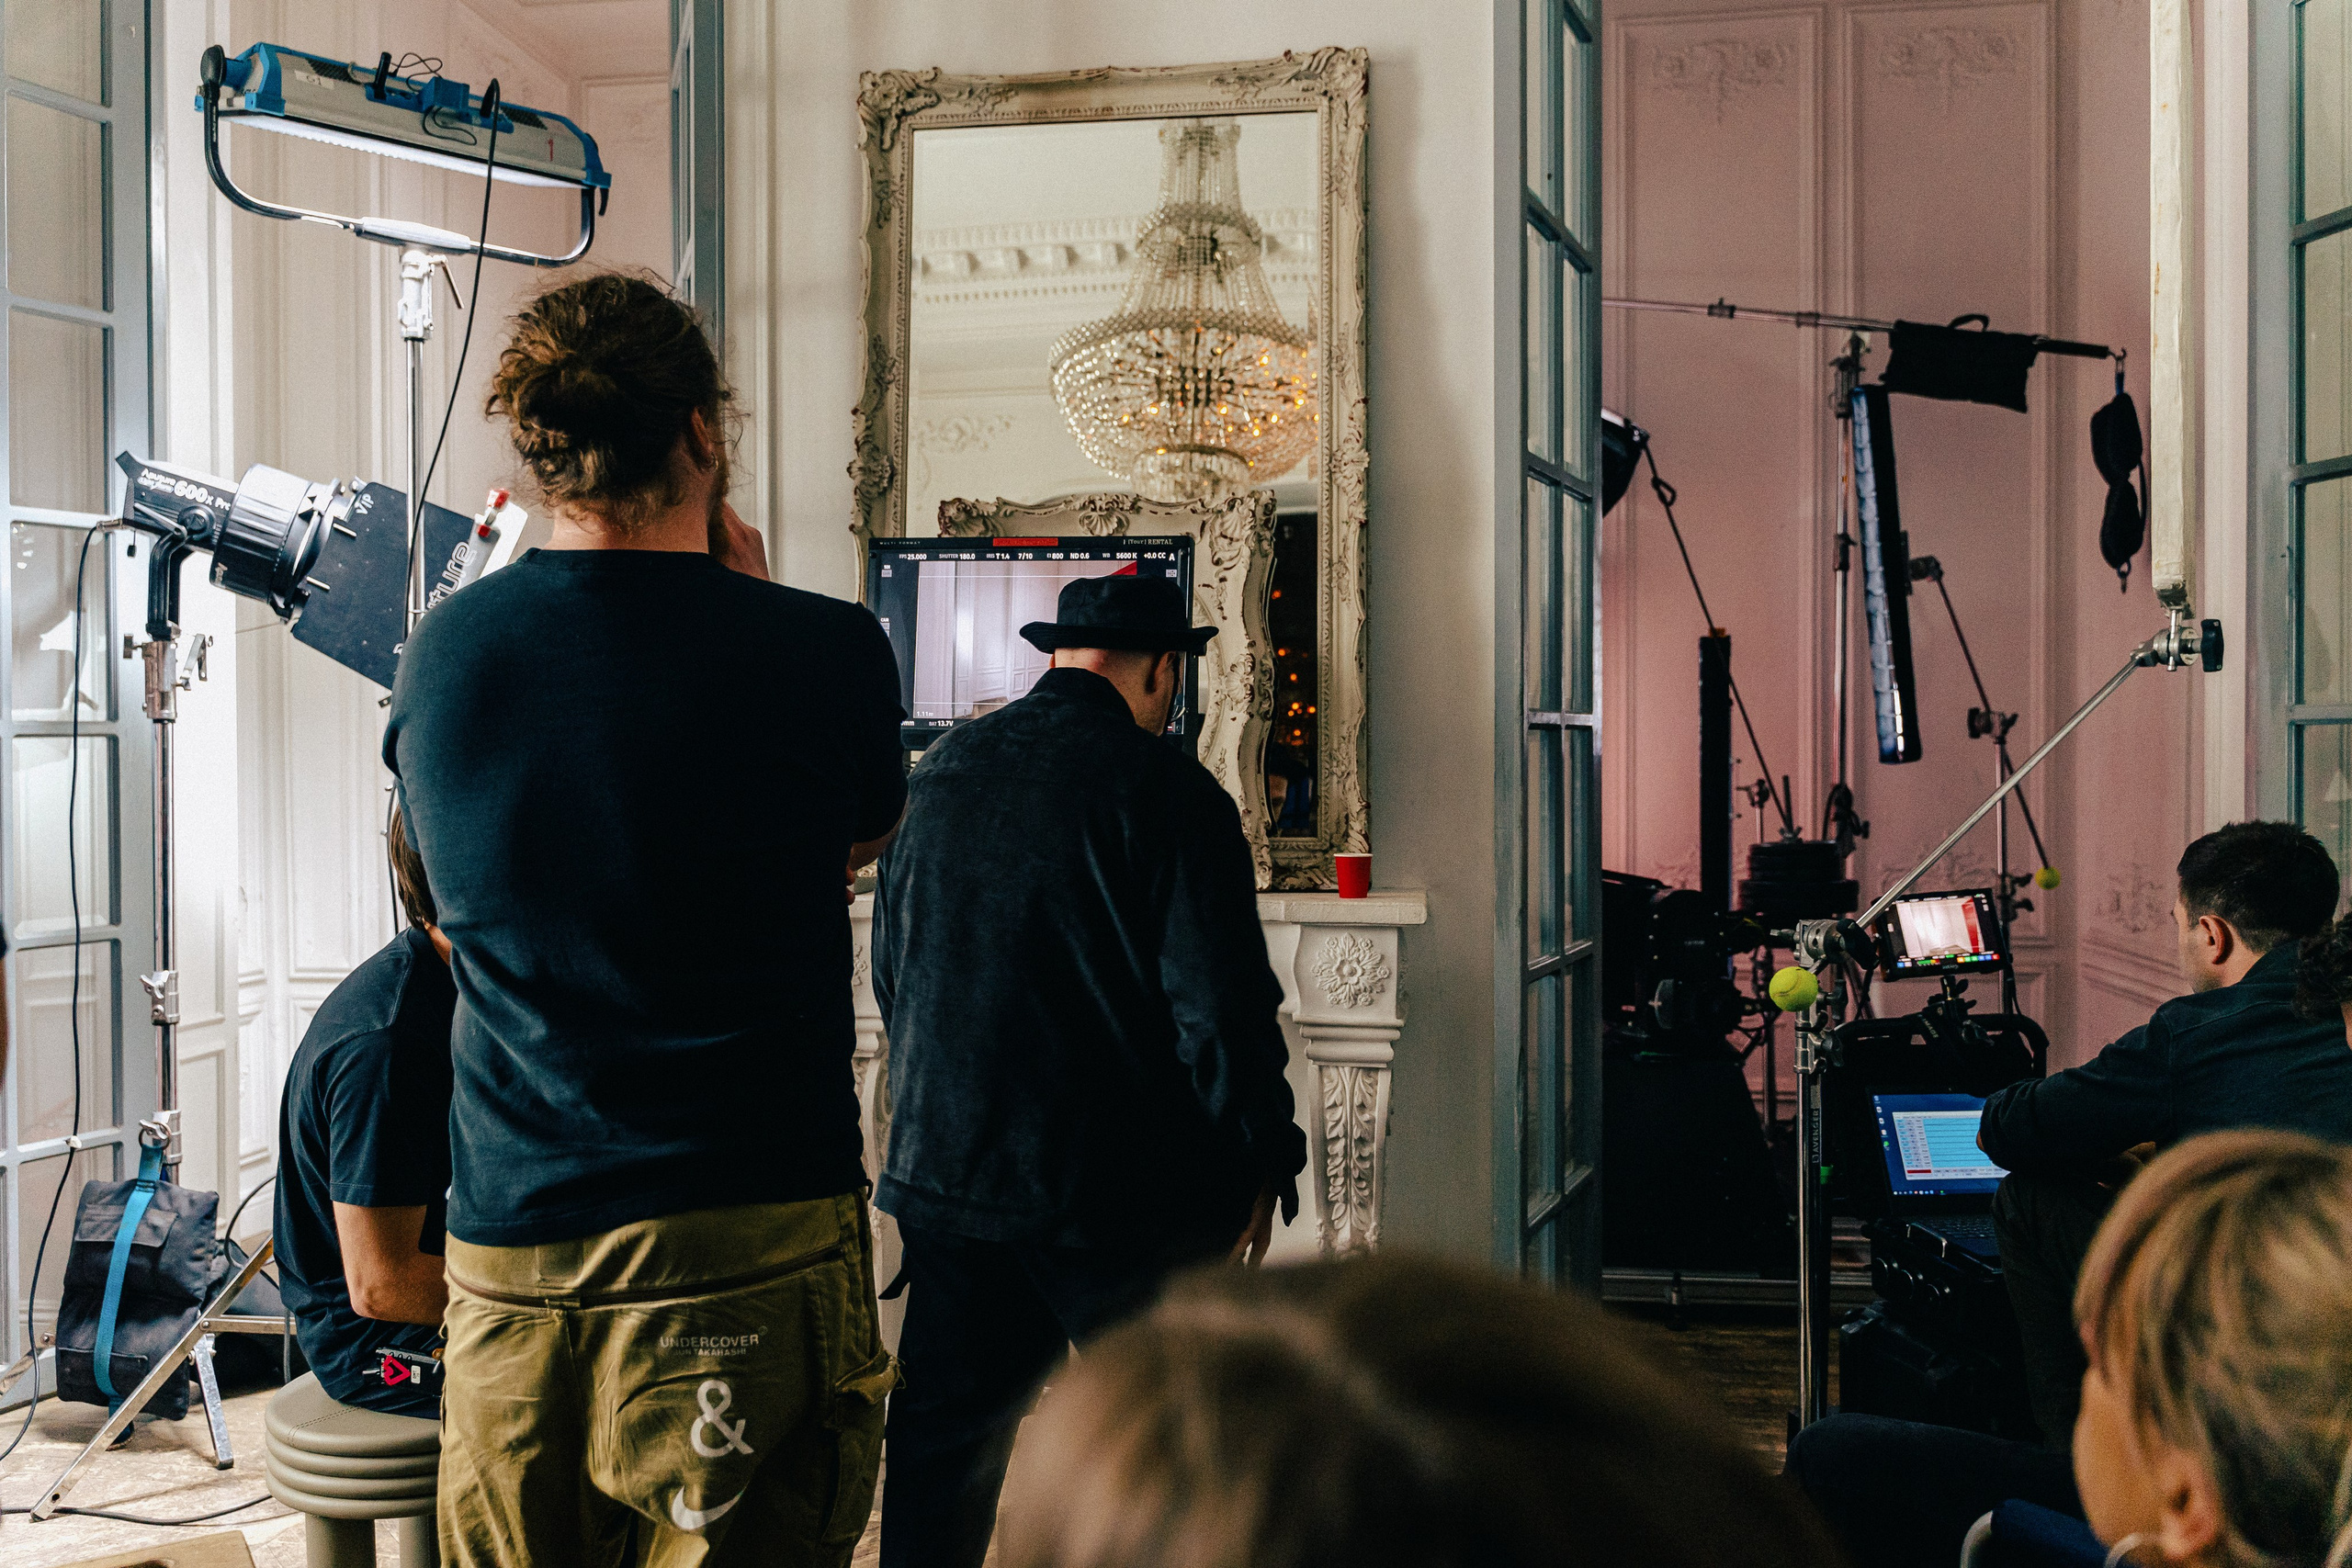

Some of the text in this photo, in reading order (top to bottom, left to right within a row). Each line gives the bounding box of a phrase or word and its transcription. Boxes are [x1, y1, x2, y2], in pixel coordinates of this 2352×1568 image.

[660, 1334, 760, 1348] UNDERCOVER
[695, 1348, 747, 1357] TAKAHASHI
[691, 1380, 754, 1459] &
